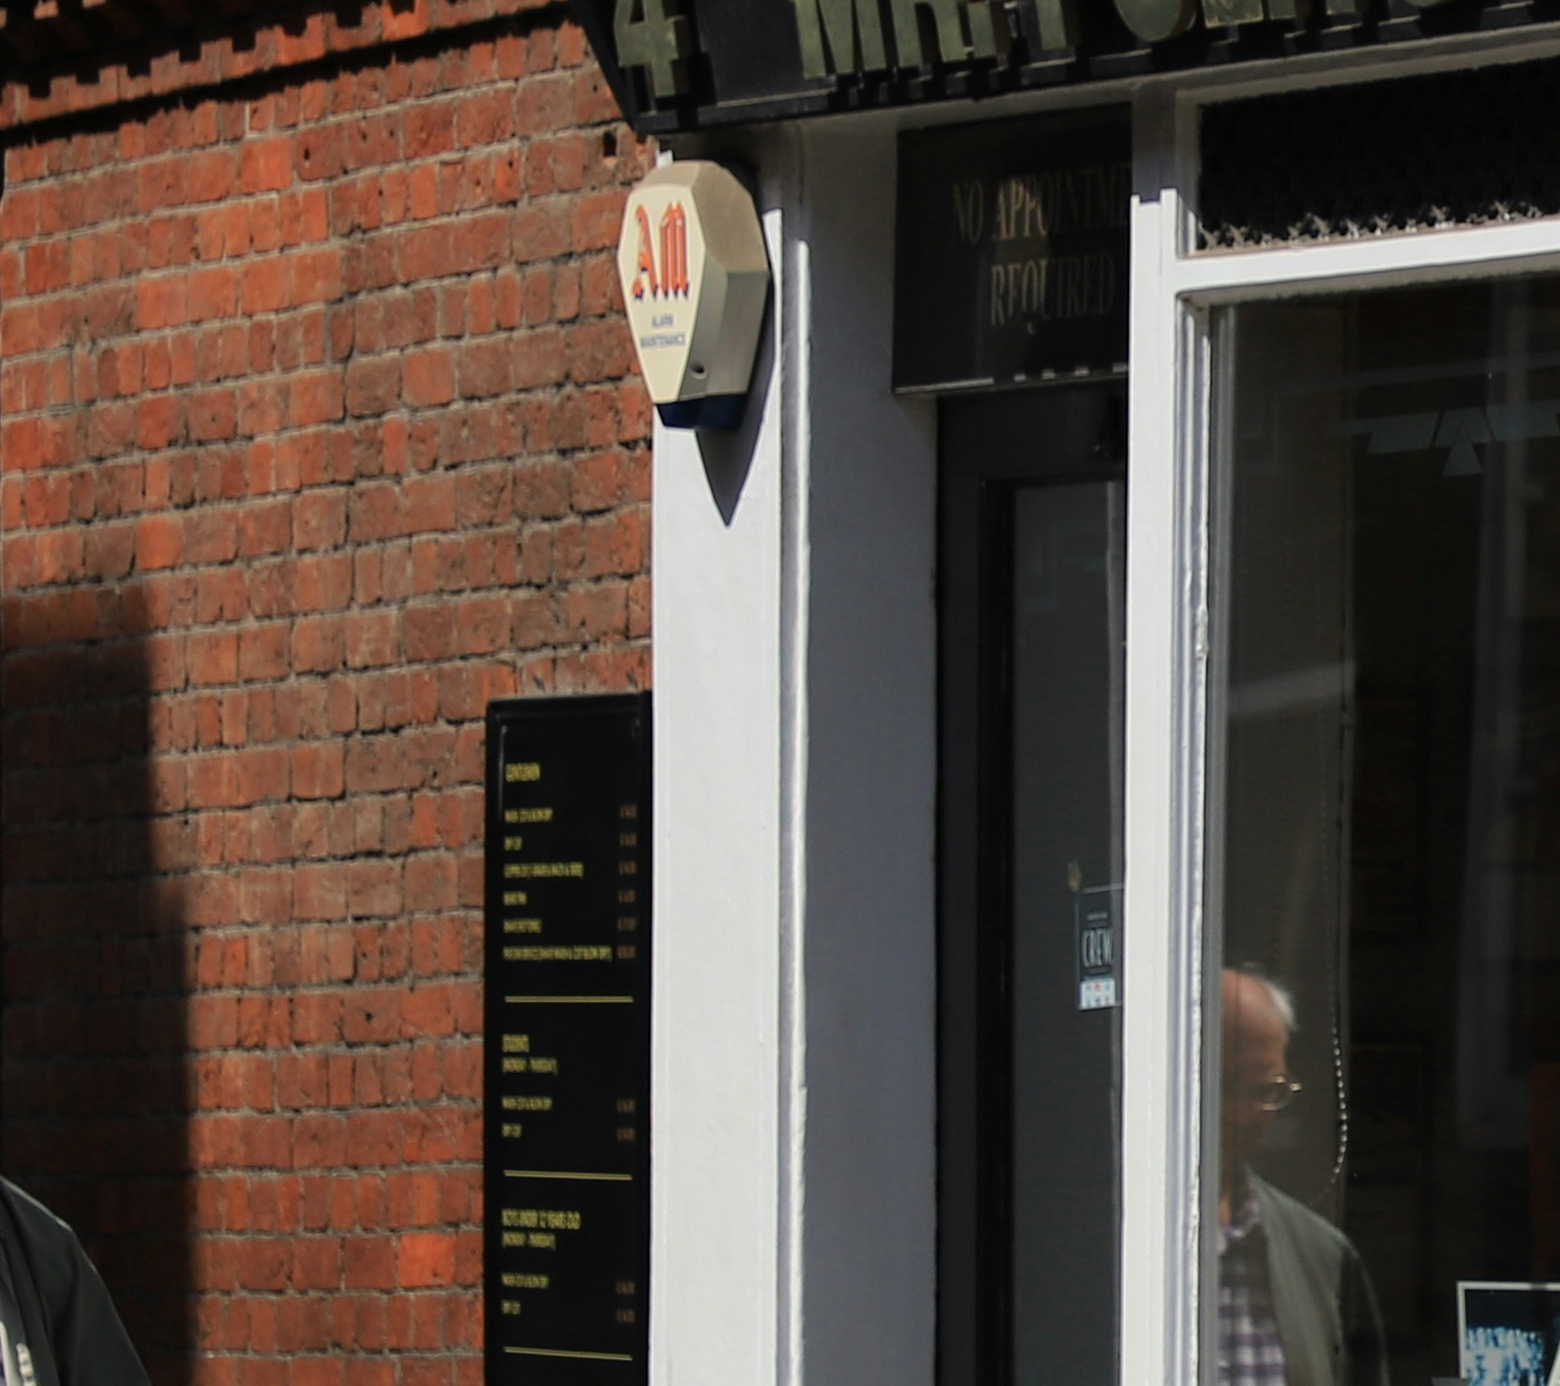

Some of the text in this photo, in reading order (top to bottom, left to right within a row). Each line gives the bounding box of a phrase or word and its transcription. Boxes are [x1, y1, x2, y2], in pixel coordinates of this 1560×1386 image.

[951, 161, 1132, 245] NO APPOINTME
[989, 252, 1116, 335] REQUIRED
[1081, 928, 1113, 968] CREW
